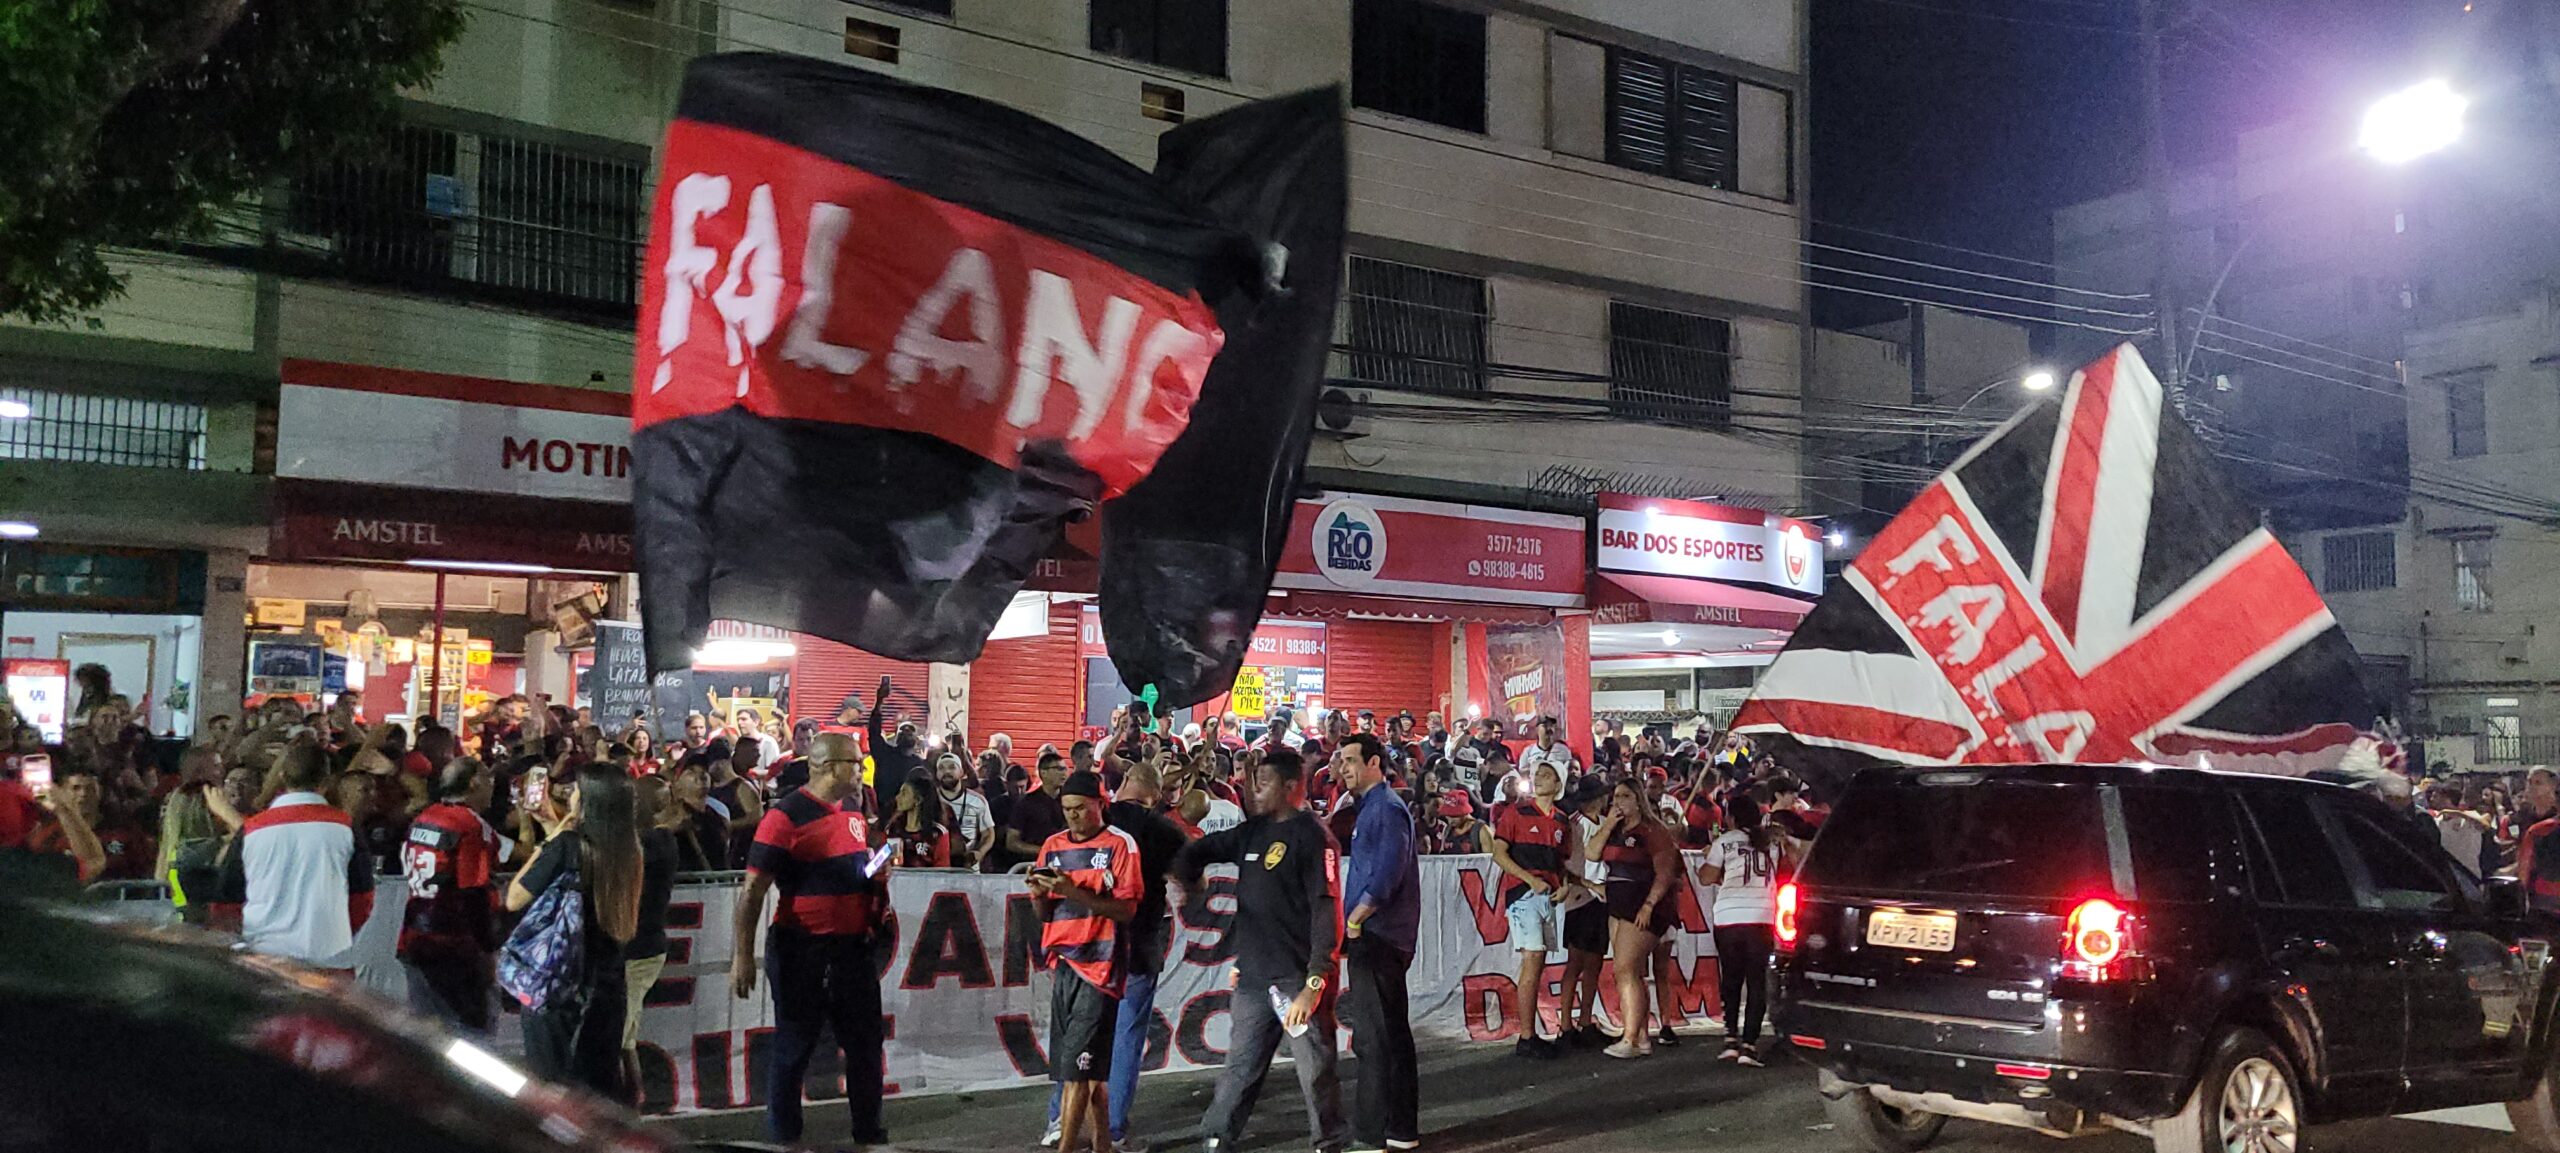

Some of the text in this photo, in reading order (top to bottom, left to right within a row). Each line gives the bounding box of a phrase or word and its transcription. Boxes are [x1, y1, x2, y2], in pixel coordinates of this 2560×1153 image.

[333, 517, 443, 546] AMSTEL
[1328, 528, 1373, 558] RIO
[1487, 534, 1542, 556] 3577-2976
[1602, 528, 1764, 562] BAR DOS ESPORTES
[1328, 556, 1372, 572] BEBIDAS
[1483, 560, 1545, 581] 98388-4815
[1695, 607, 1743, 623] AMSTEL
[1503, 667, 1543, 699] BRAHMA
